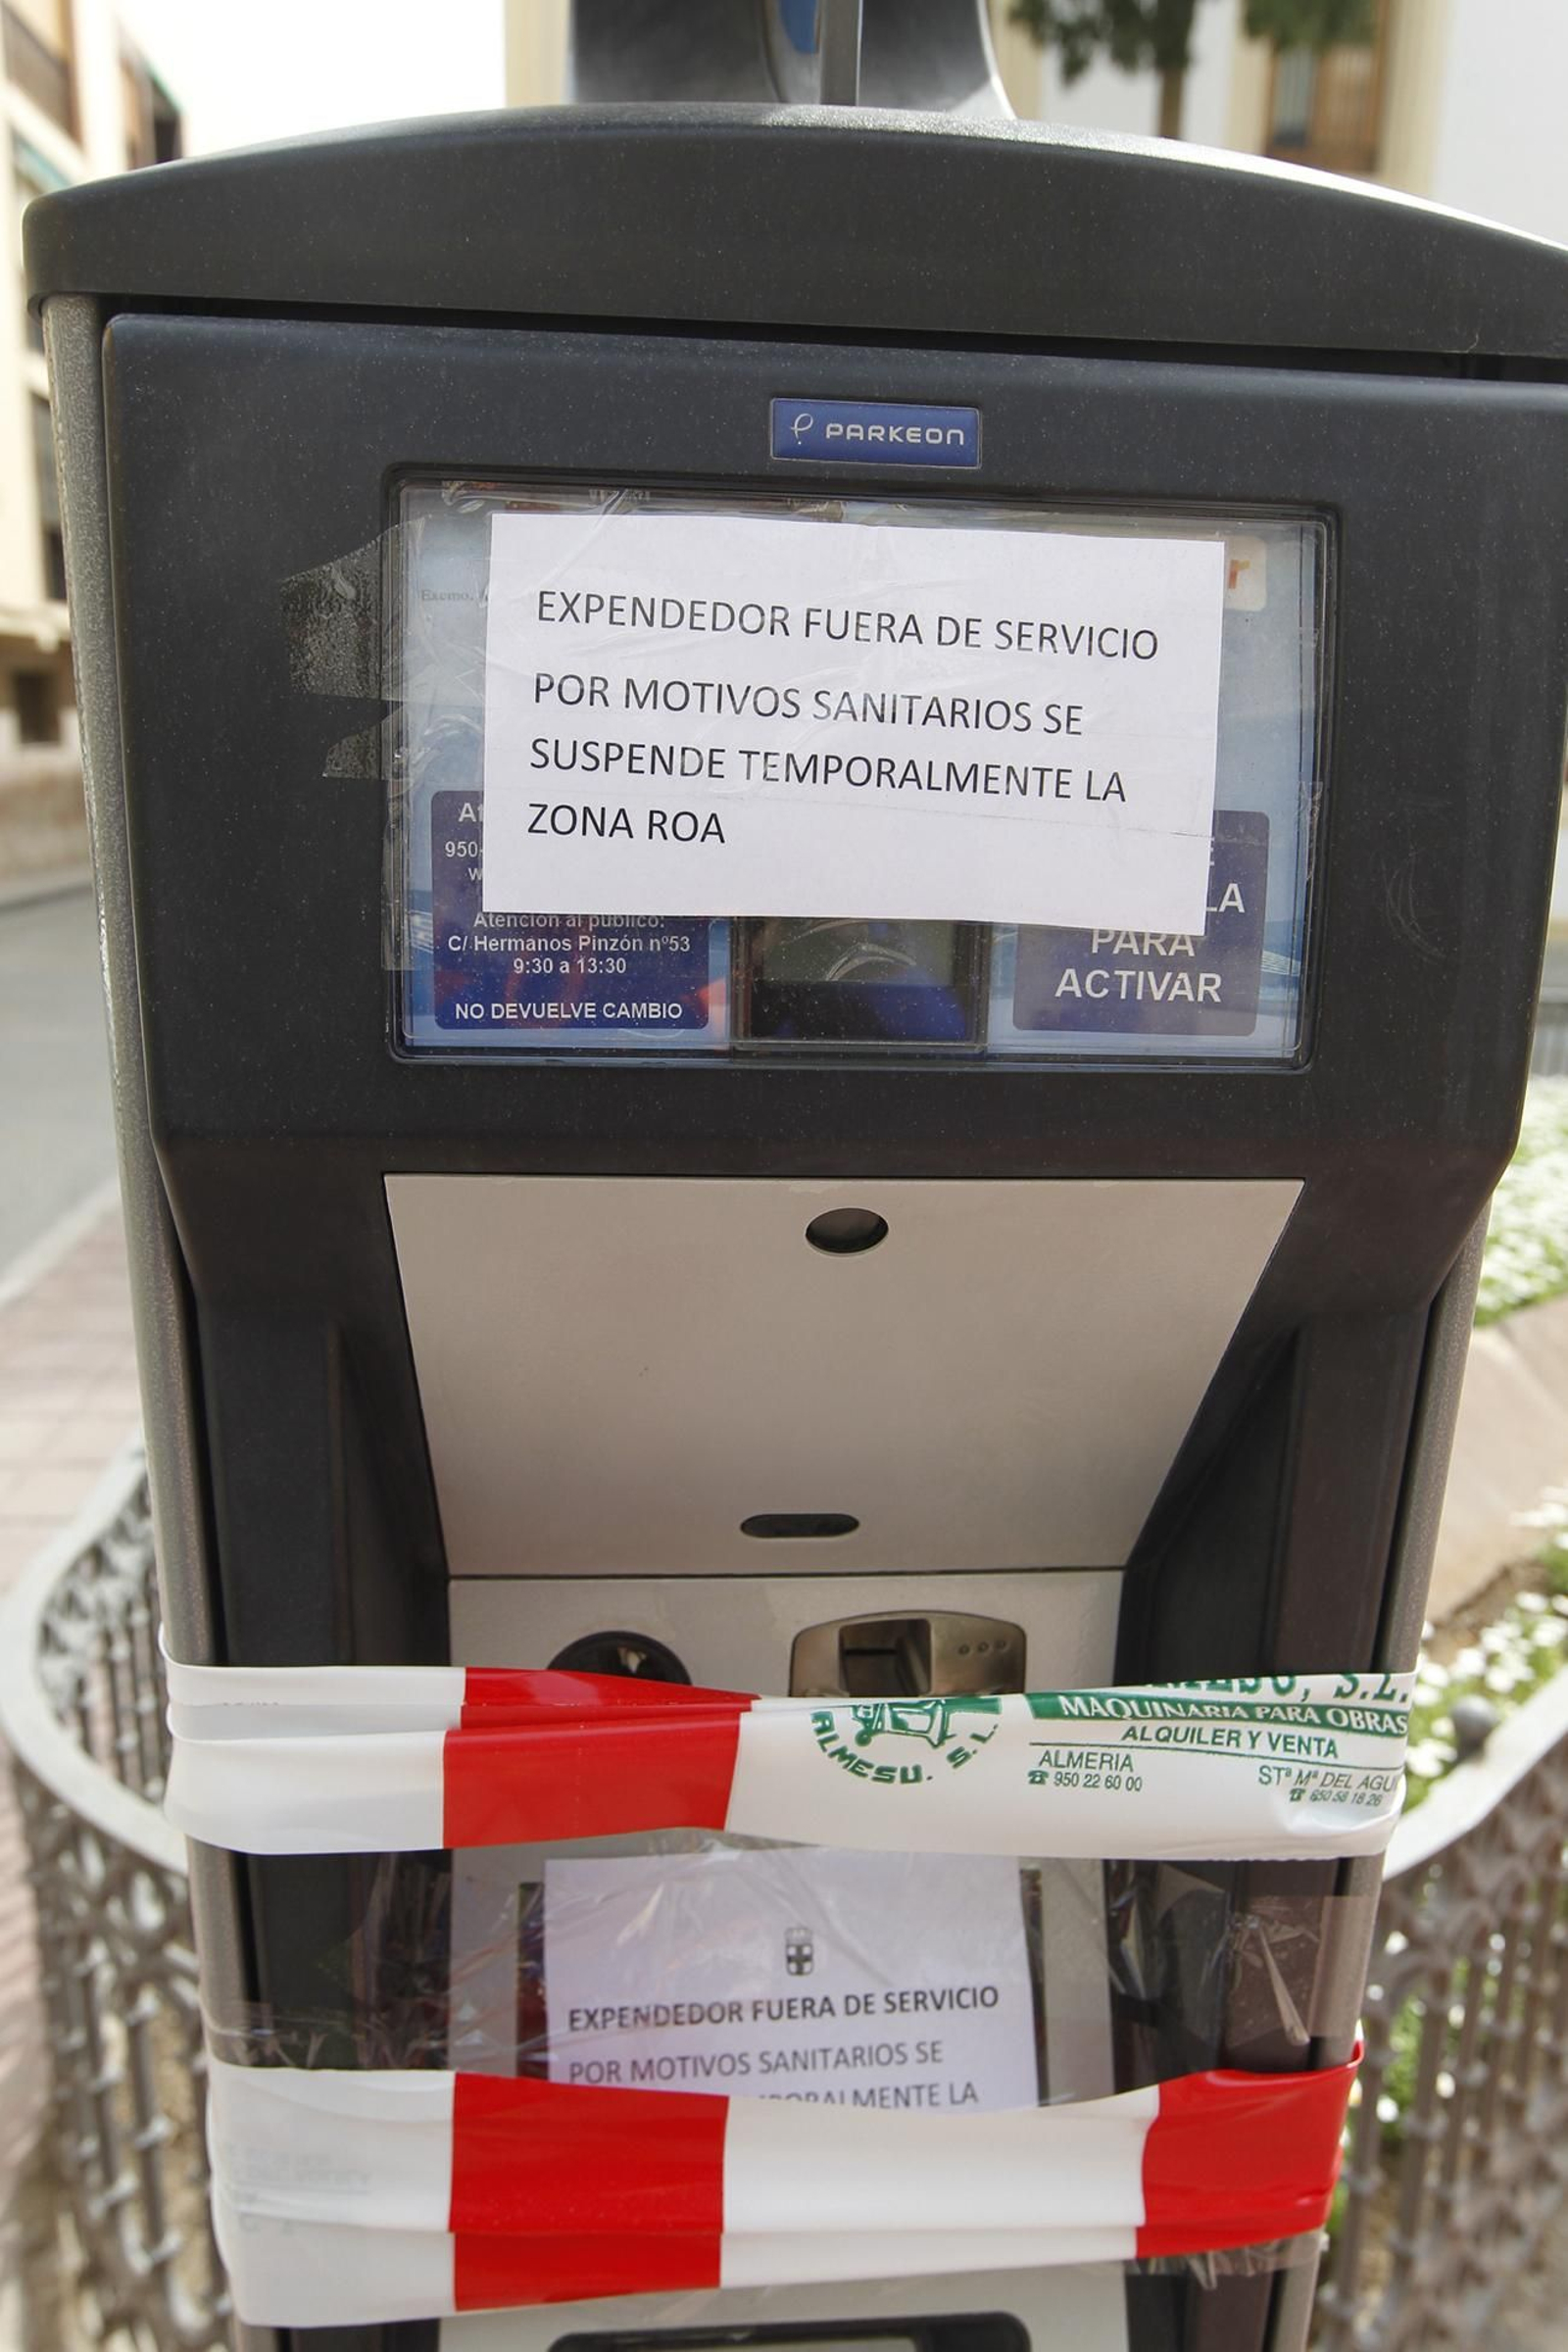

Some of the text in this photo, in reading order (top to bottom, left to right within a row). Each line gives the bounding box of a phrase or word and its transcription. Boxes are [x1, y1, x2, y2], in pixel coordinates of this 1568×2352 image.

[826, 423, 964, 445] PARKEON
[538, 591, 1158, 660] EXPENDEDOR FUERA DE SERVICIO
[534, 672, 1083, 735] POR MOTIVOS SANITARIOS SE
[529, 738, 1126, 803] SUSPENDE TEMPORALMENTE LA
[527, 803, 726, 844] ZONA ROA
[565, 914, 582, 928] al
[448, 935, 691, 952] C/ Hermanos Pinzón nº53
[1091, 929, 1196, 957] PARA
[514, 958, 626, 974] 9:30 a 13:30
[1054, 968, 1222, 1003] ACTIVAR
[455, 1003, 683, 1019] NO DEVUELVE CAMBIO
[1058, 1695, 1408, 1734] MAQUINARIA PARA OBRAS
[1121, 1725, 1339, 1758] ALQUILER Y VENTA
[1039, 1749, 1134, 1773] ALMERIA
[1320, 1772, 1352, 1789] DEL
[1054, 1771, 1079, 1787] 950
[1083, 1773, 1101, 1788] 22
[1104, 1774, 1122, 1790] 60
[1125, 1776, 1143, 1791] 00
[568, 1985, 999, 2033] EXPENDEDOR FUERA DE SERVICIO
[569, 2040, 943, 2084] POR MOTIVOS SANITARIOS SE
[948, 2082, 979, 2105] LA
